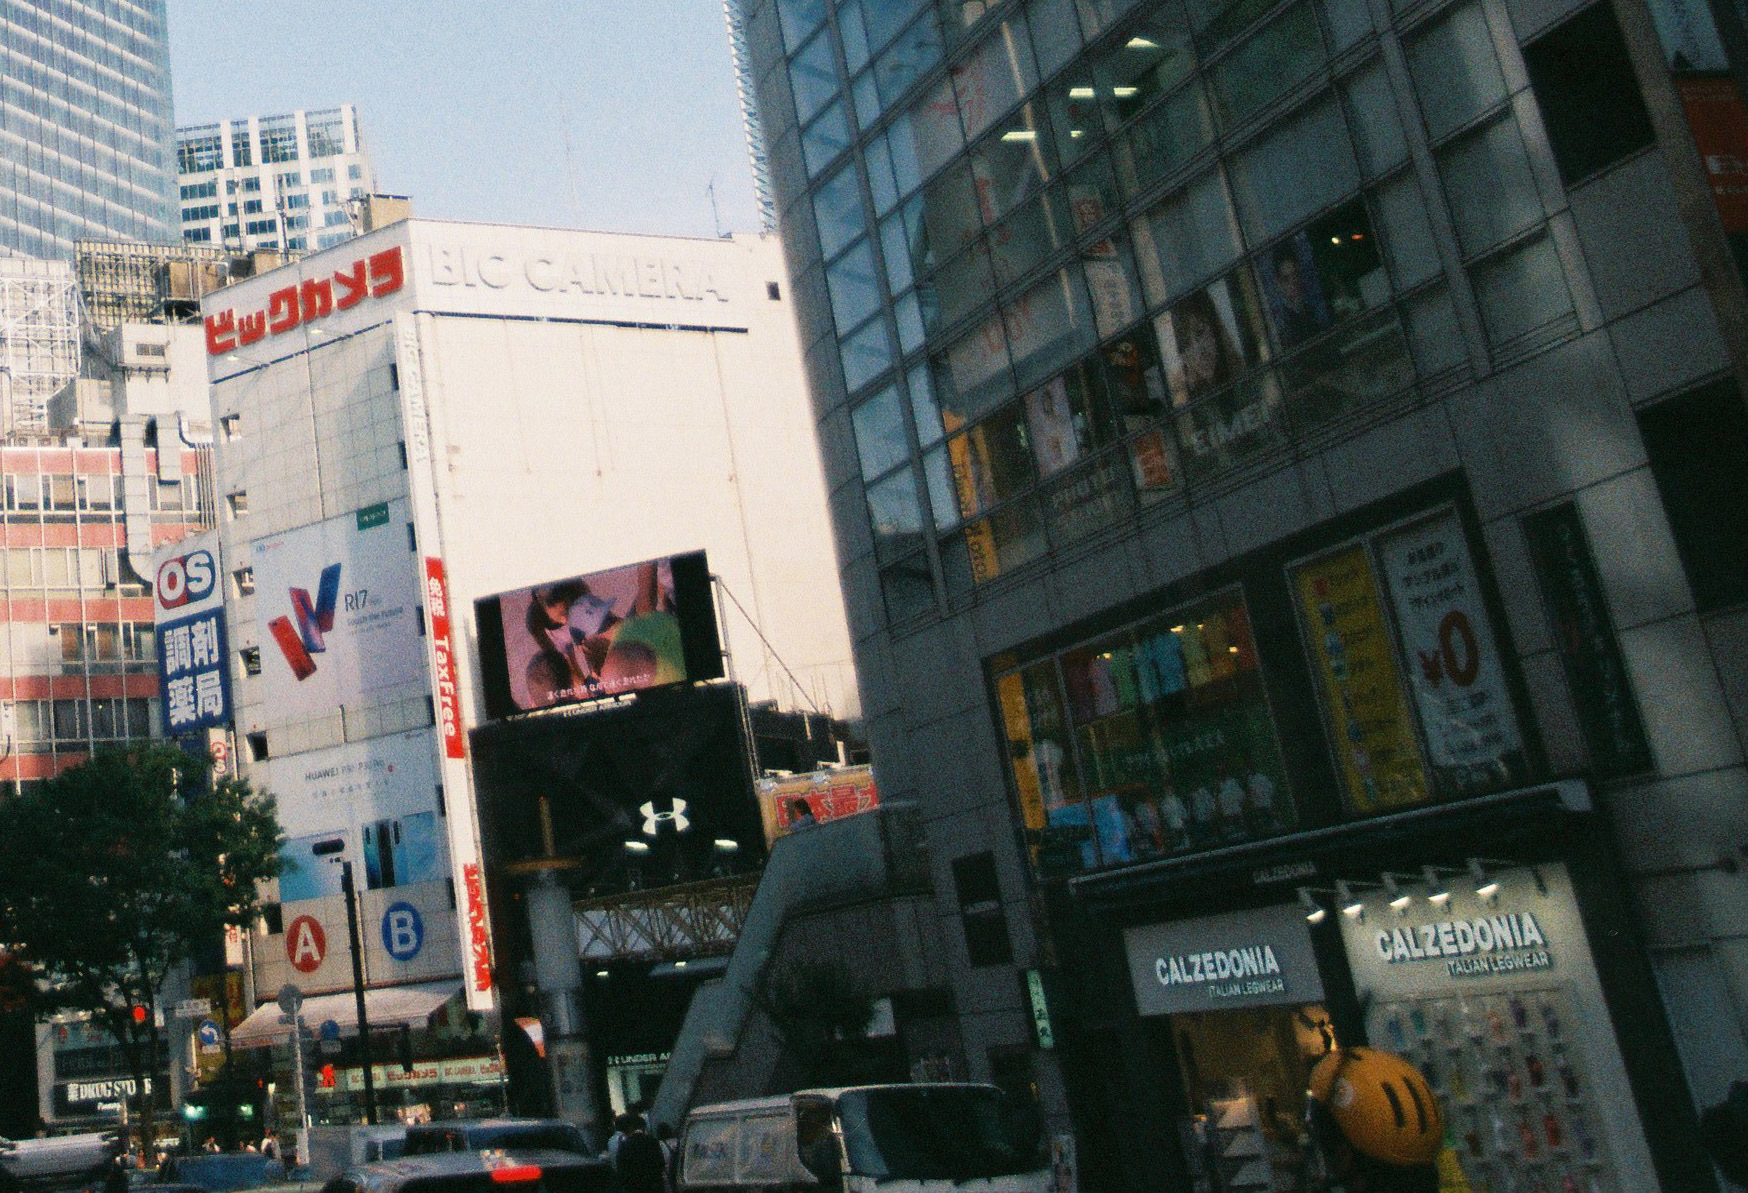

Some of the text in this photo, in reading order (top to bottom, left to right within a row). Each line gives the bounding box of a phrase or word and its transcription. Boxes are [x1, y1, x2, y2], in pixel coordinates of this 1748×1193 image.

[429, 243, 731, 304] BIC CAMERA
[204, 245, 406, 356] ビックカメラ
[159, 551, 212, 603] OS
[344, 588, 368, 612] R17
[164, 616, 219, 676] 調剤
[167, 669, 223, 726] 薬局
[435, 635, 457, 738] TaxFree
[305, 766, 339, 782] HUAWEI
[295, 919, 321, 967] A
[390, 908, 417, 955] B
[1376, 912, 1545, 963] CALZEDONIA
[1155, 945, 1281, 987] CALZEDONIA
[1445, 951, 1550, 976] ITALIAN LEGWEAR
